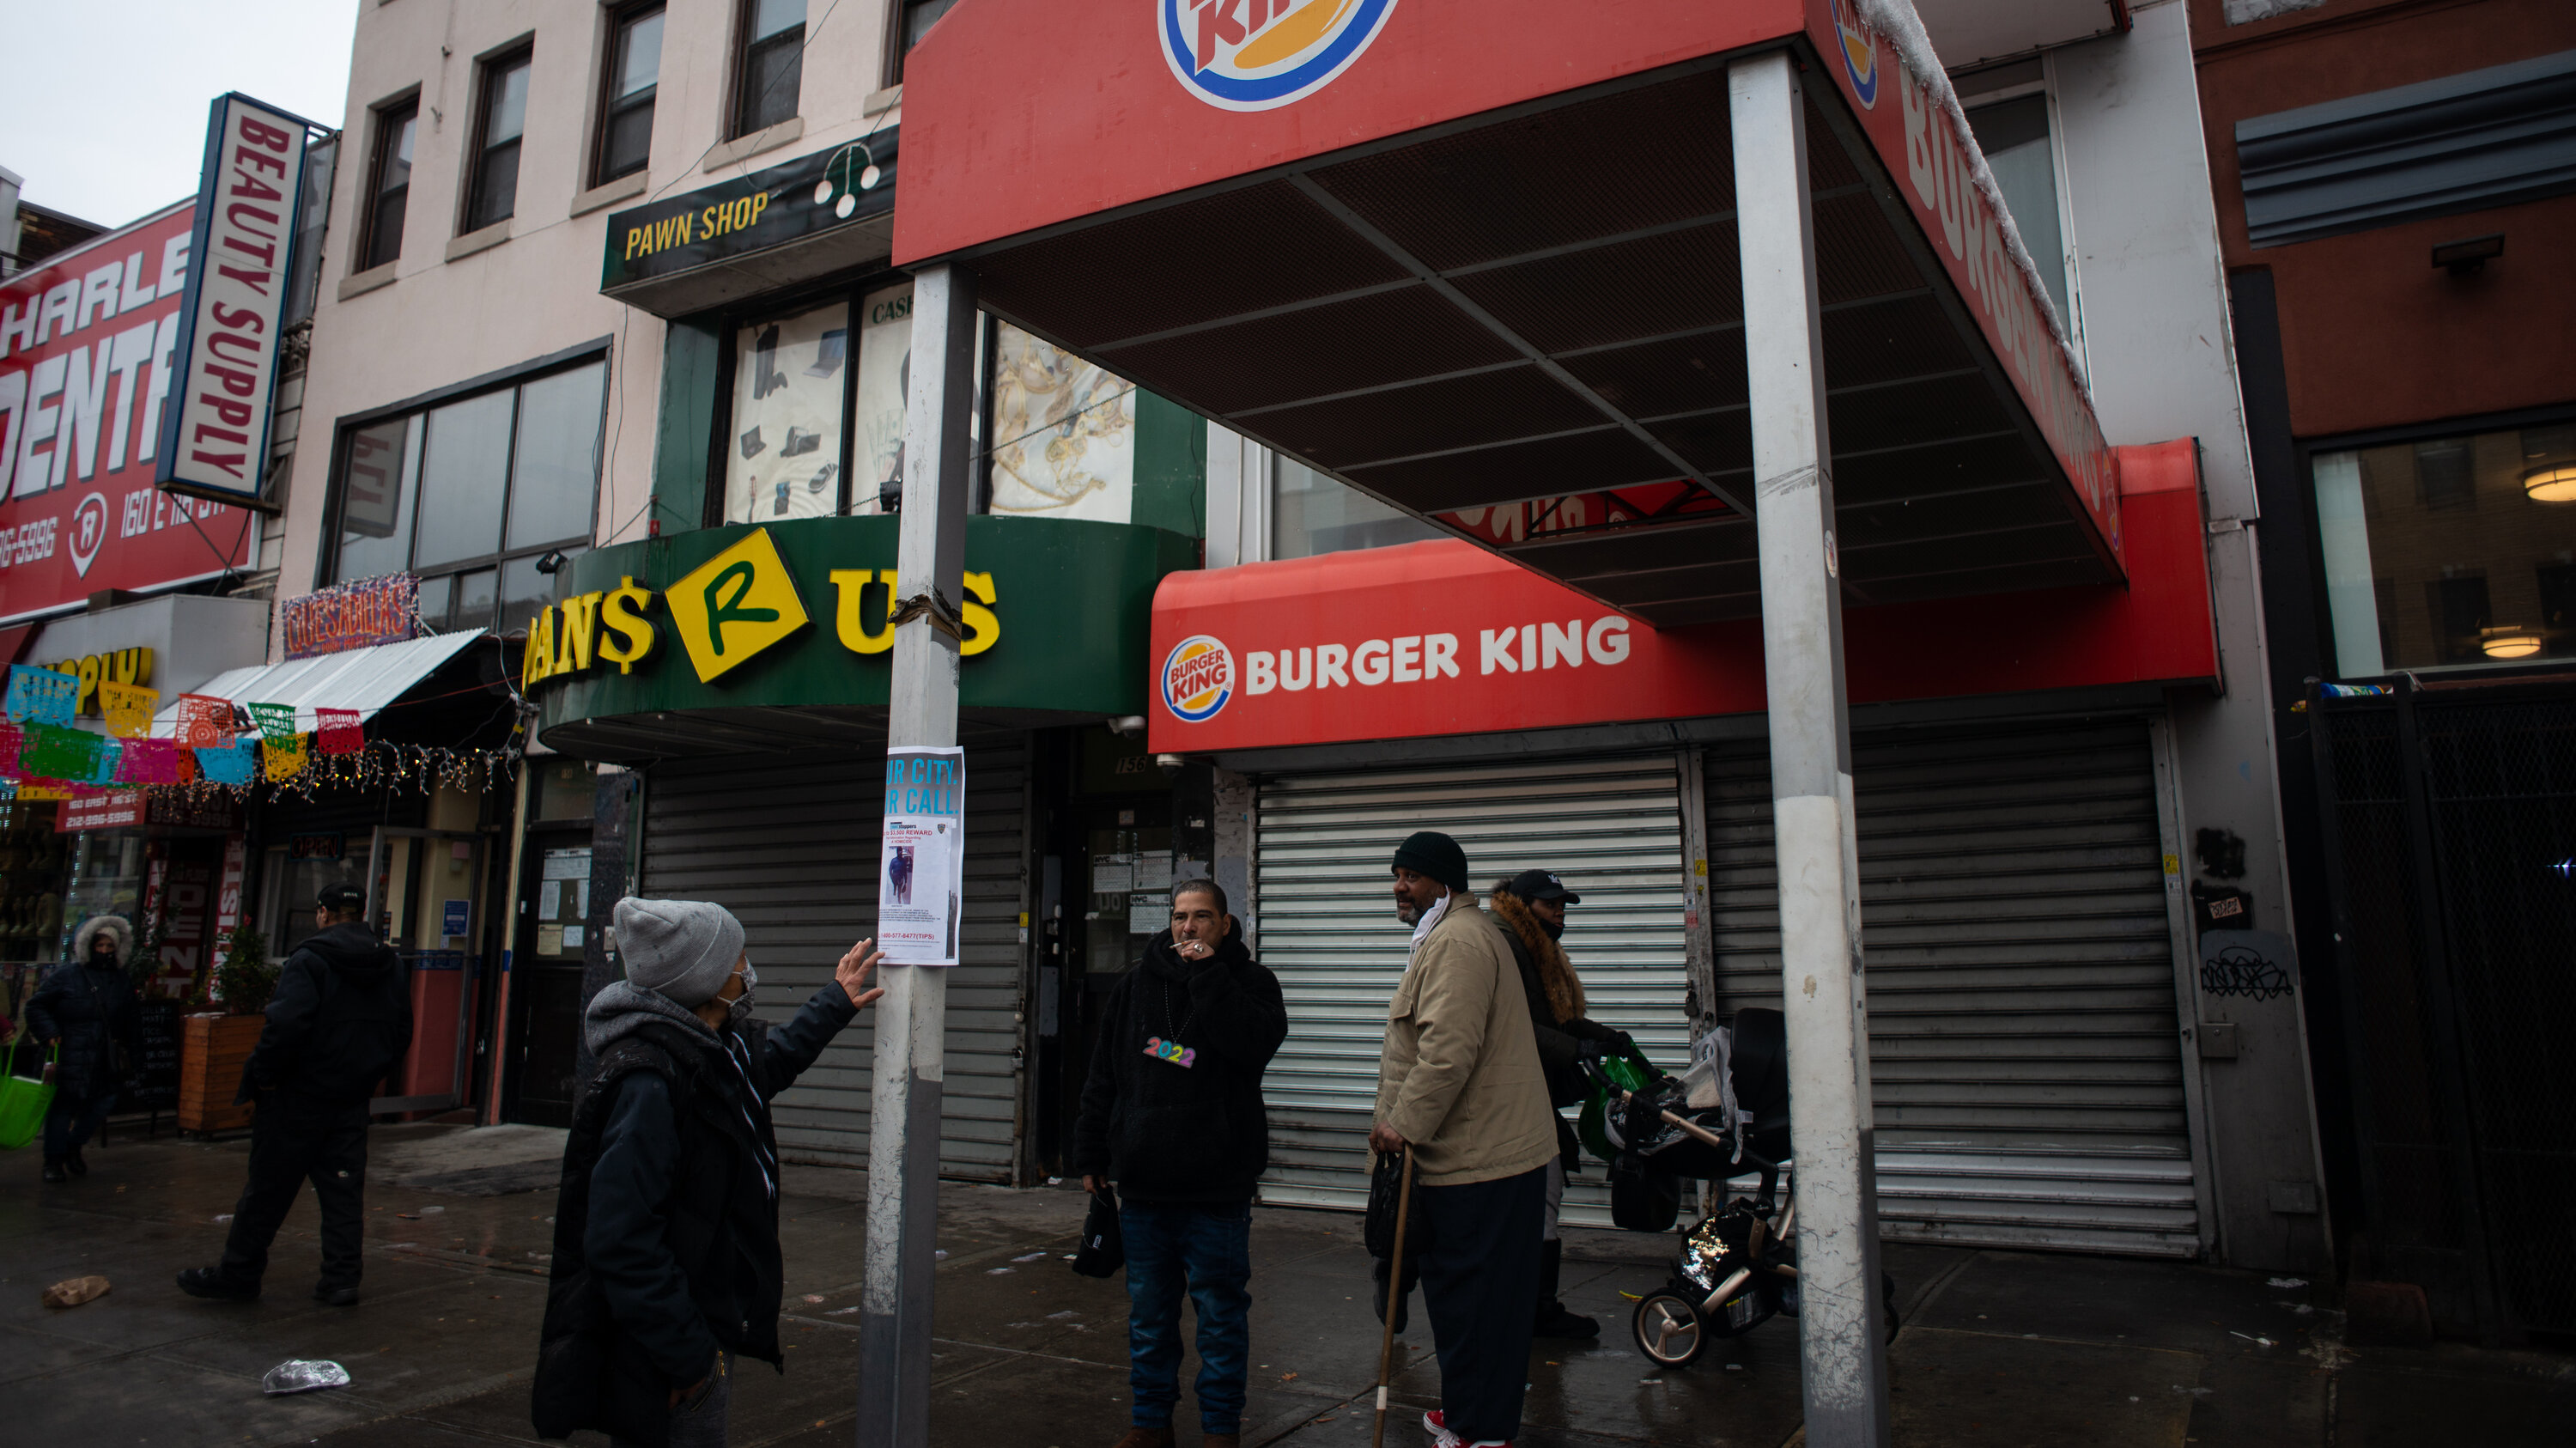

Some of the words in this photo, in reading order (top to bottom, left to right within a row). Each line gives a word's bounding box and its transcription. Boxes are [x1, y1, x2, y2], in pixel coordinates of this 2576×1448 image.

[218, 115, 290, 297] BEAUTY
[625, 210, 692, 261] PAWN
[700, 191, 769, 242] SHOP
[1899, 62, 2046, 415] BURGER
[191, 301, 264, 480] SUPPLY
[121, 488, 153, 539] 160
[288, 585, 405, 653] QUESADILLAS
[703, 560, 779, 657] R
[1170, 649, 1225, 684] BURGER
[1246, 632, 1461, 697] BURGER
[1479, 615, 1631, 677] KING
[1172, 662, 1227, 706] KING
[912, 757, 957, 785] CITY.
[1119, 757, 1145, 772] 156
[65, 811, 137, 828] 212-996-5996
[69, 800, 84, 810] 160
[85, 795, 108, 808] EAST
[906, 788, 958, 814] CALL.
[291, 837, 337, 858] OPEN
[1145, 1037, 1195, 1067] 2022
